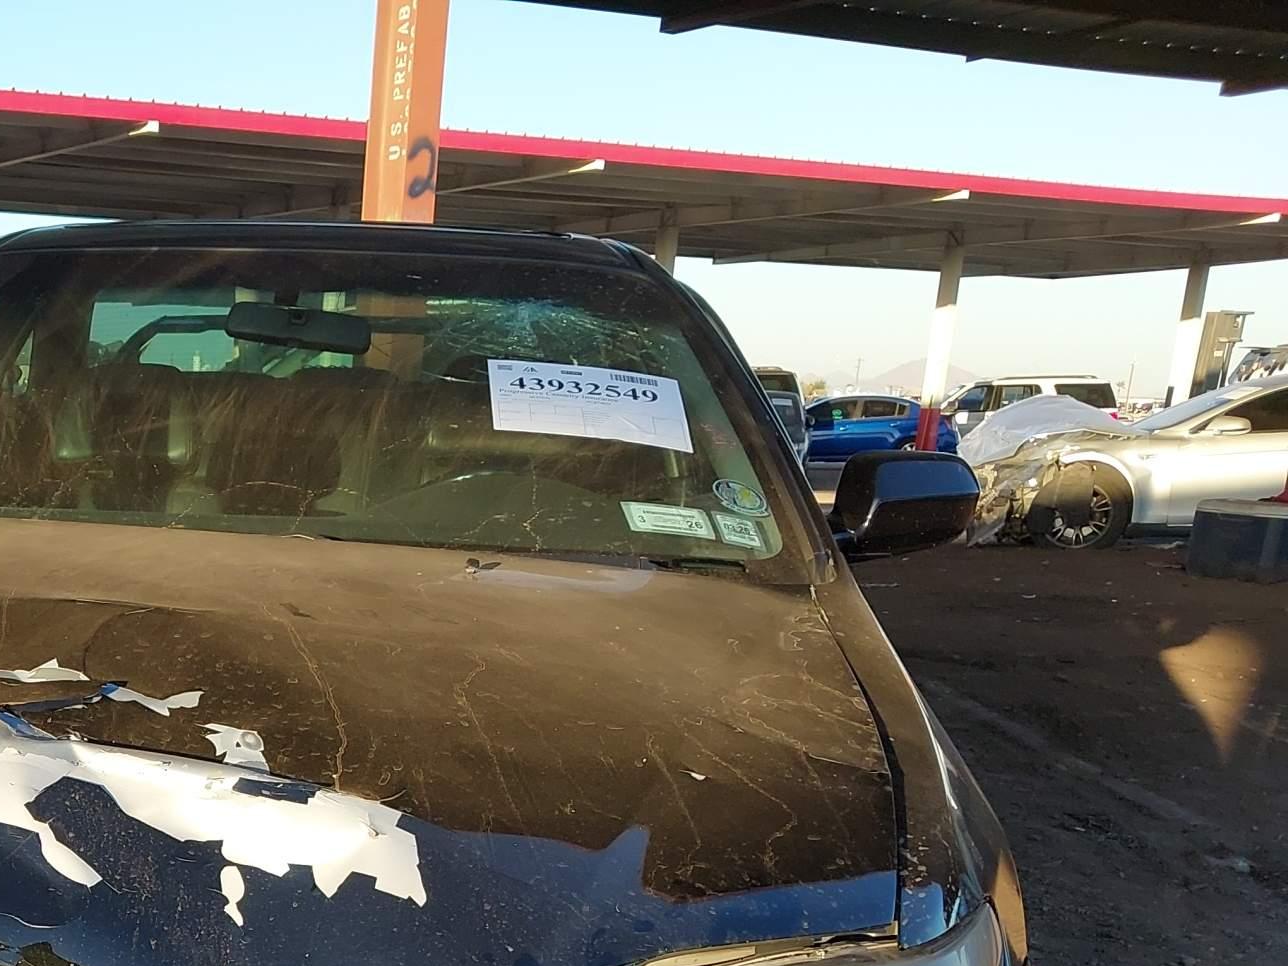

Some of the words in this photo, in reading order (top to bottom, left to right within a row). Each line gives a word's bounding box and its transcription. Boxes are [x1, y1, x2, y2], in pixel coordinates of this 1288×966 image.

[393, 4, 411, 101] PREFAB
[408, 135, 436, 199] 2
[509, 376, 659, 403] 43932549
